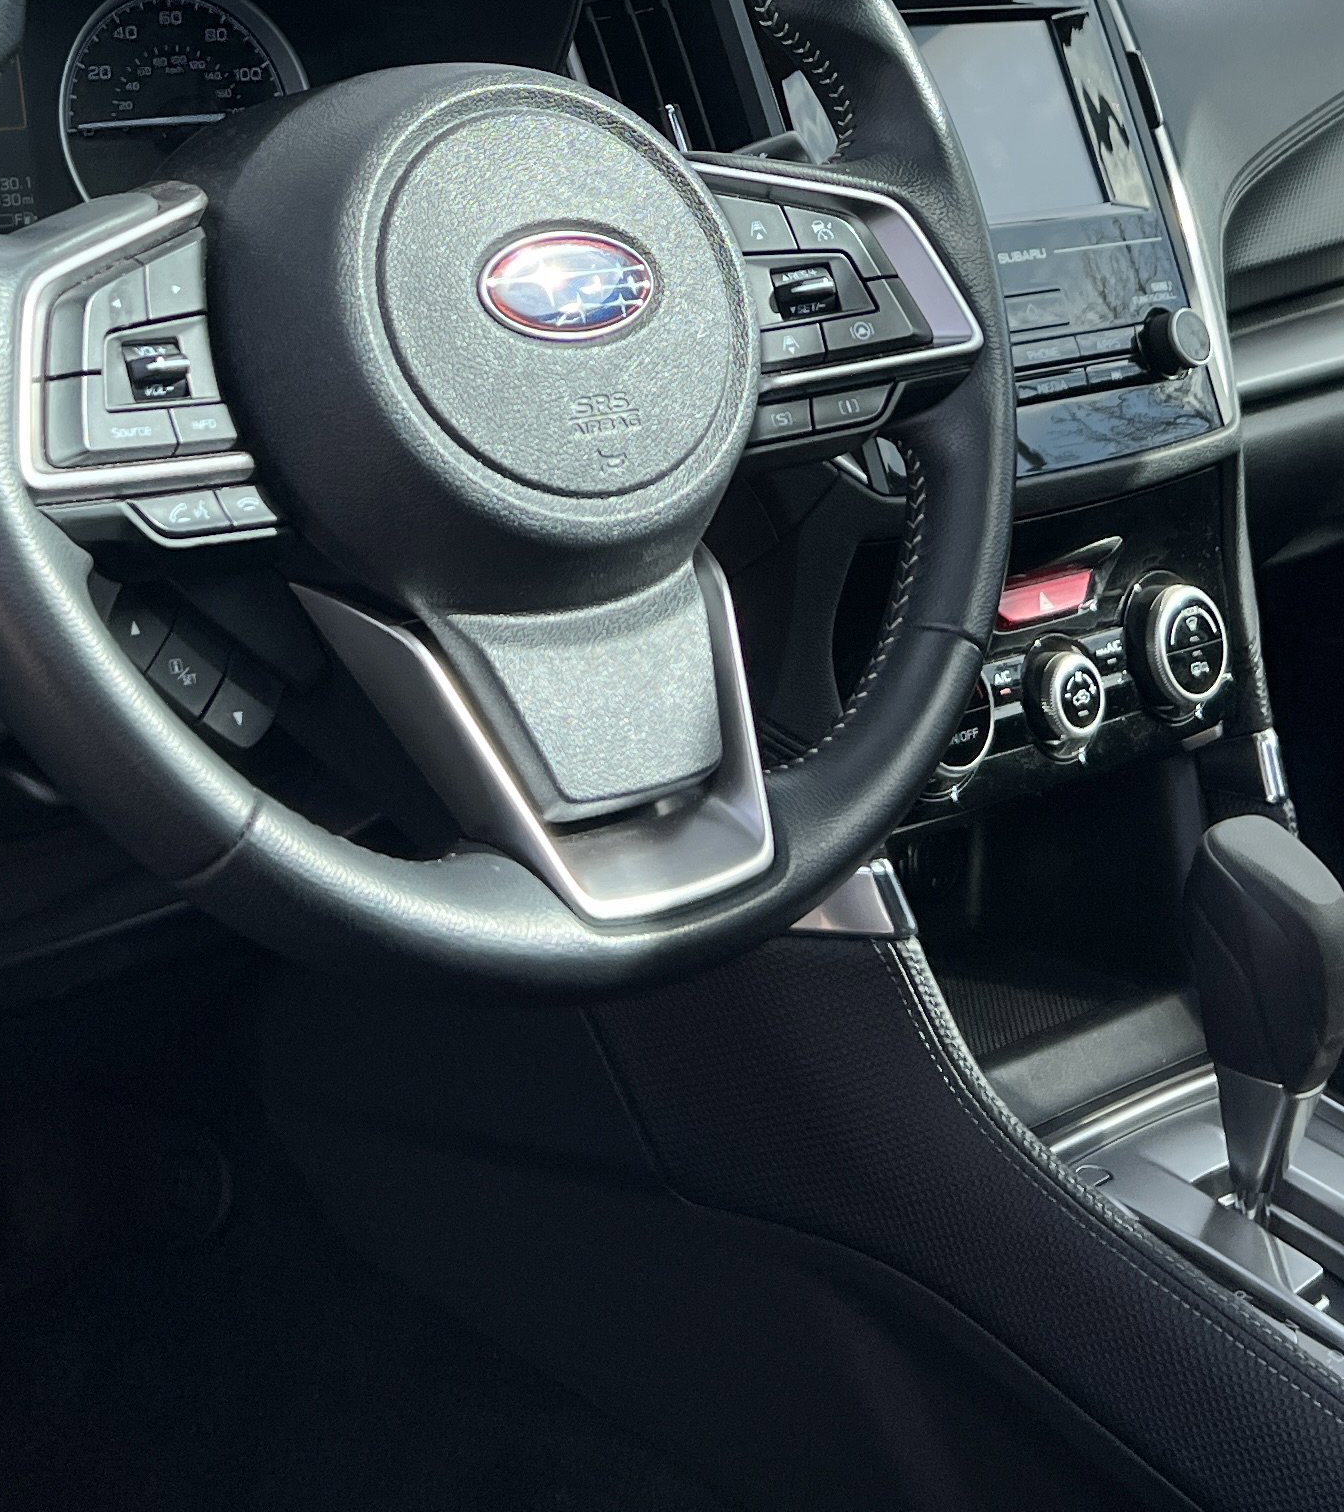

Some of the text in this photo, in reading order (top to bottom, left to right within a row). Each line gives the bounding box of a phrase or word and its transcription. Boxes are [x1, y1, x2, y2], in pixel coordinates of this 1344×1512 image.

[158, 10, 183, 26] 60
[113, 24, 138, 40] 40
[205, 27, 228, 42] 80
[87, 65, 112, 80] 20
[233, 67, 263, 81] 100
[14, 213, 23, 226] F
[997, 248, 1047, 264] SUBARU
[575, 391, 630, 414] SRS
[192, 418, 217, 430] INFO
